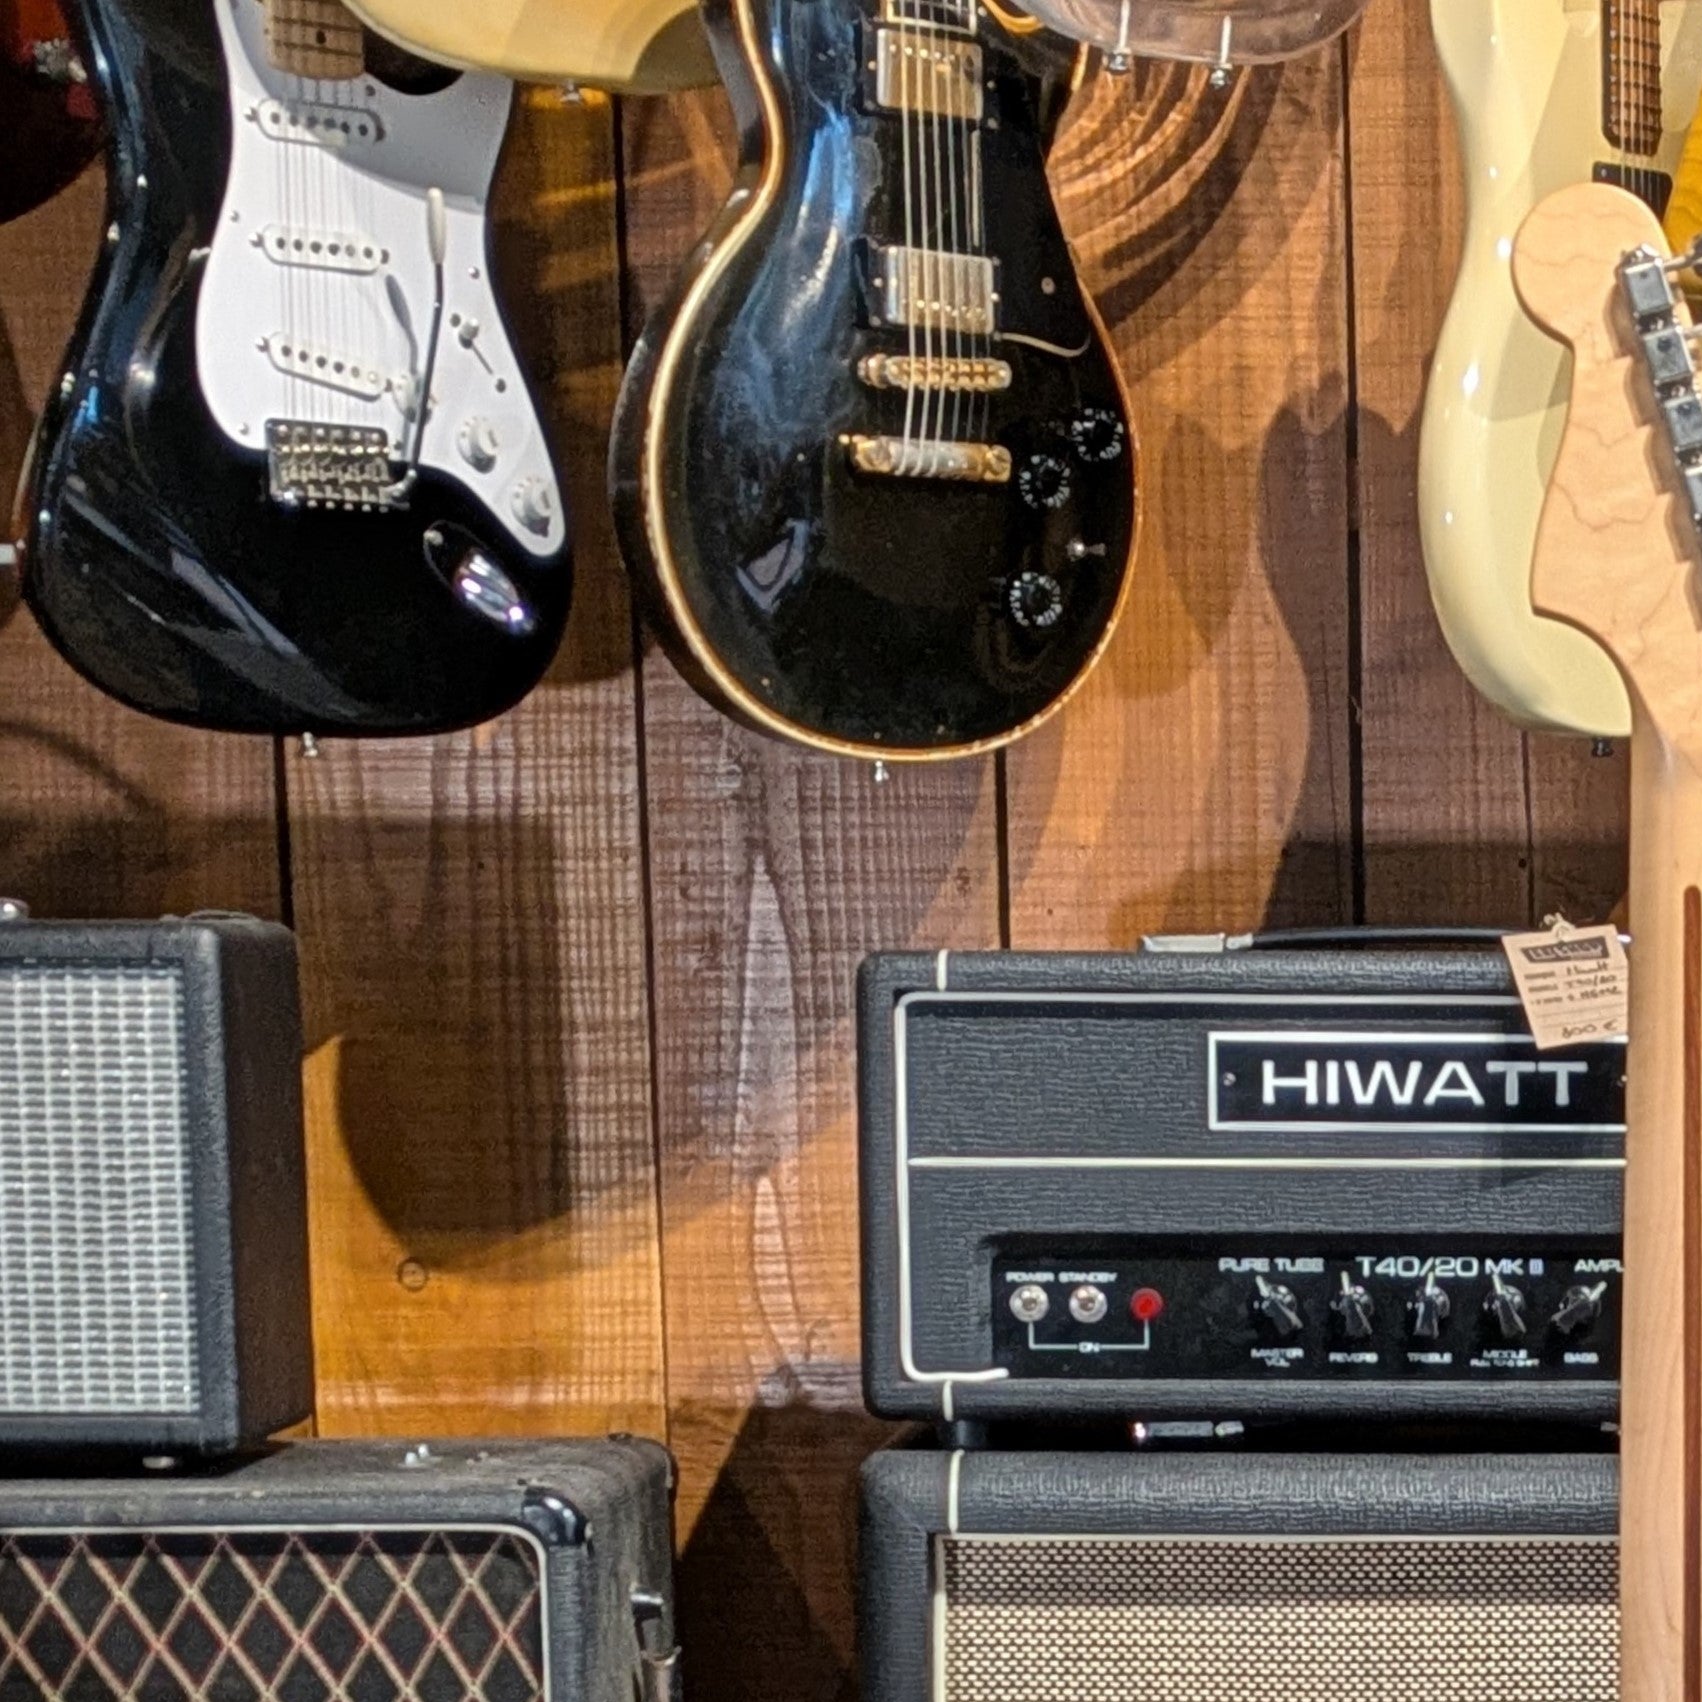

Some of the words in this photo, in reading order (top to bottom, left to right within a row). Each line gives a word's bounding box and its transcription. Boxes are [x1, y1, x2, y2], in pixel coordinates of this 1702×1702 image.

[1262, 1060, 1588, 1106] HIWATT
[1218, 1257, 1270, 1273] PURE
[1274, 1257, 1324, 1273] TUBE
[1355, 1256, 1478, 1277] T40/20
[1484, 1258, 1524, 1275] MK
[1005, 1271, 1055, 1283] POWER
[1058, 1271, 1118, 1283] STANDBY
[1329, 1352, 1378, 1363] REVERB
[1407, 1352, 1452, 1364] TREBLE
[1564, 1352, 1598, 1364] BASS
